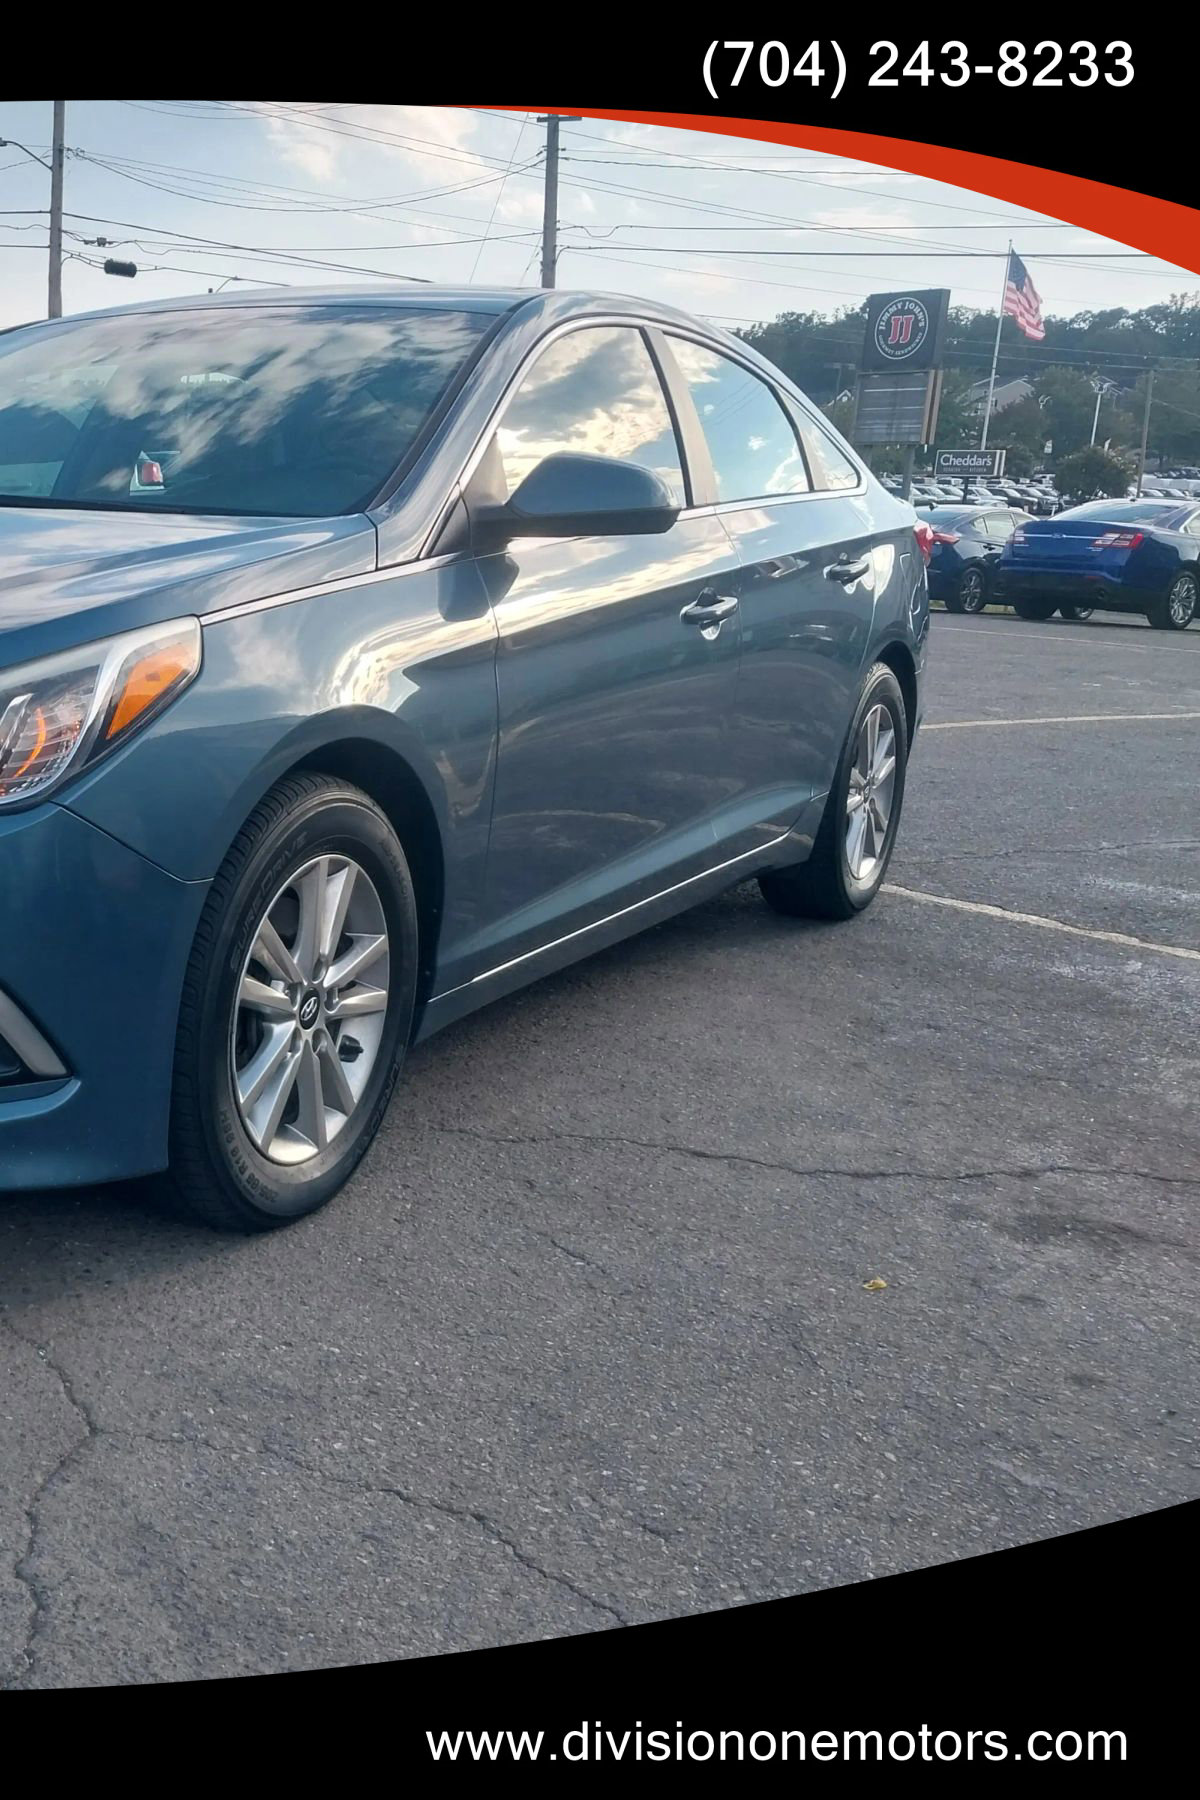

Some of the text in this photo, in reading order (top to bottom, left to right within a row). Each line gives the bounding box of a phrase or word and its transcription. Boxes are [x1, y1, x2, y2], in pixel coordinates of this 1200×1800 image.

[879, 302, 903, 330] JIMMY
[888, 314, 915, 344] JJ
[940, 454, 992, 466] Cheddar's
